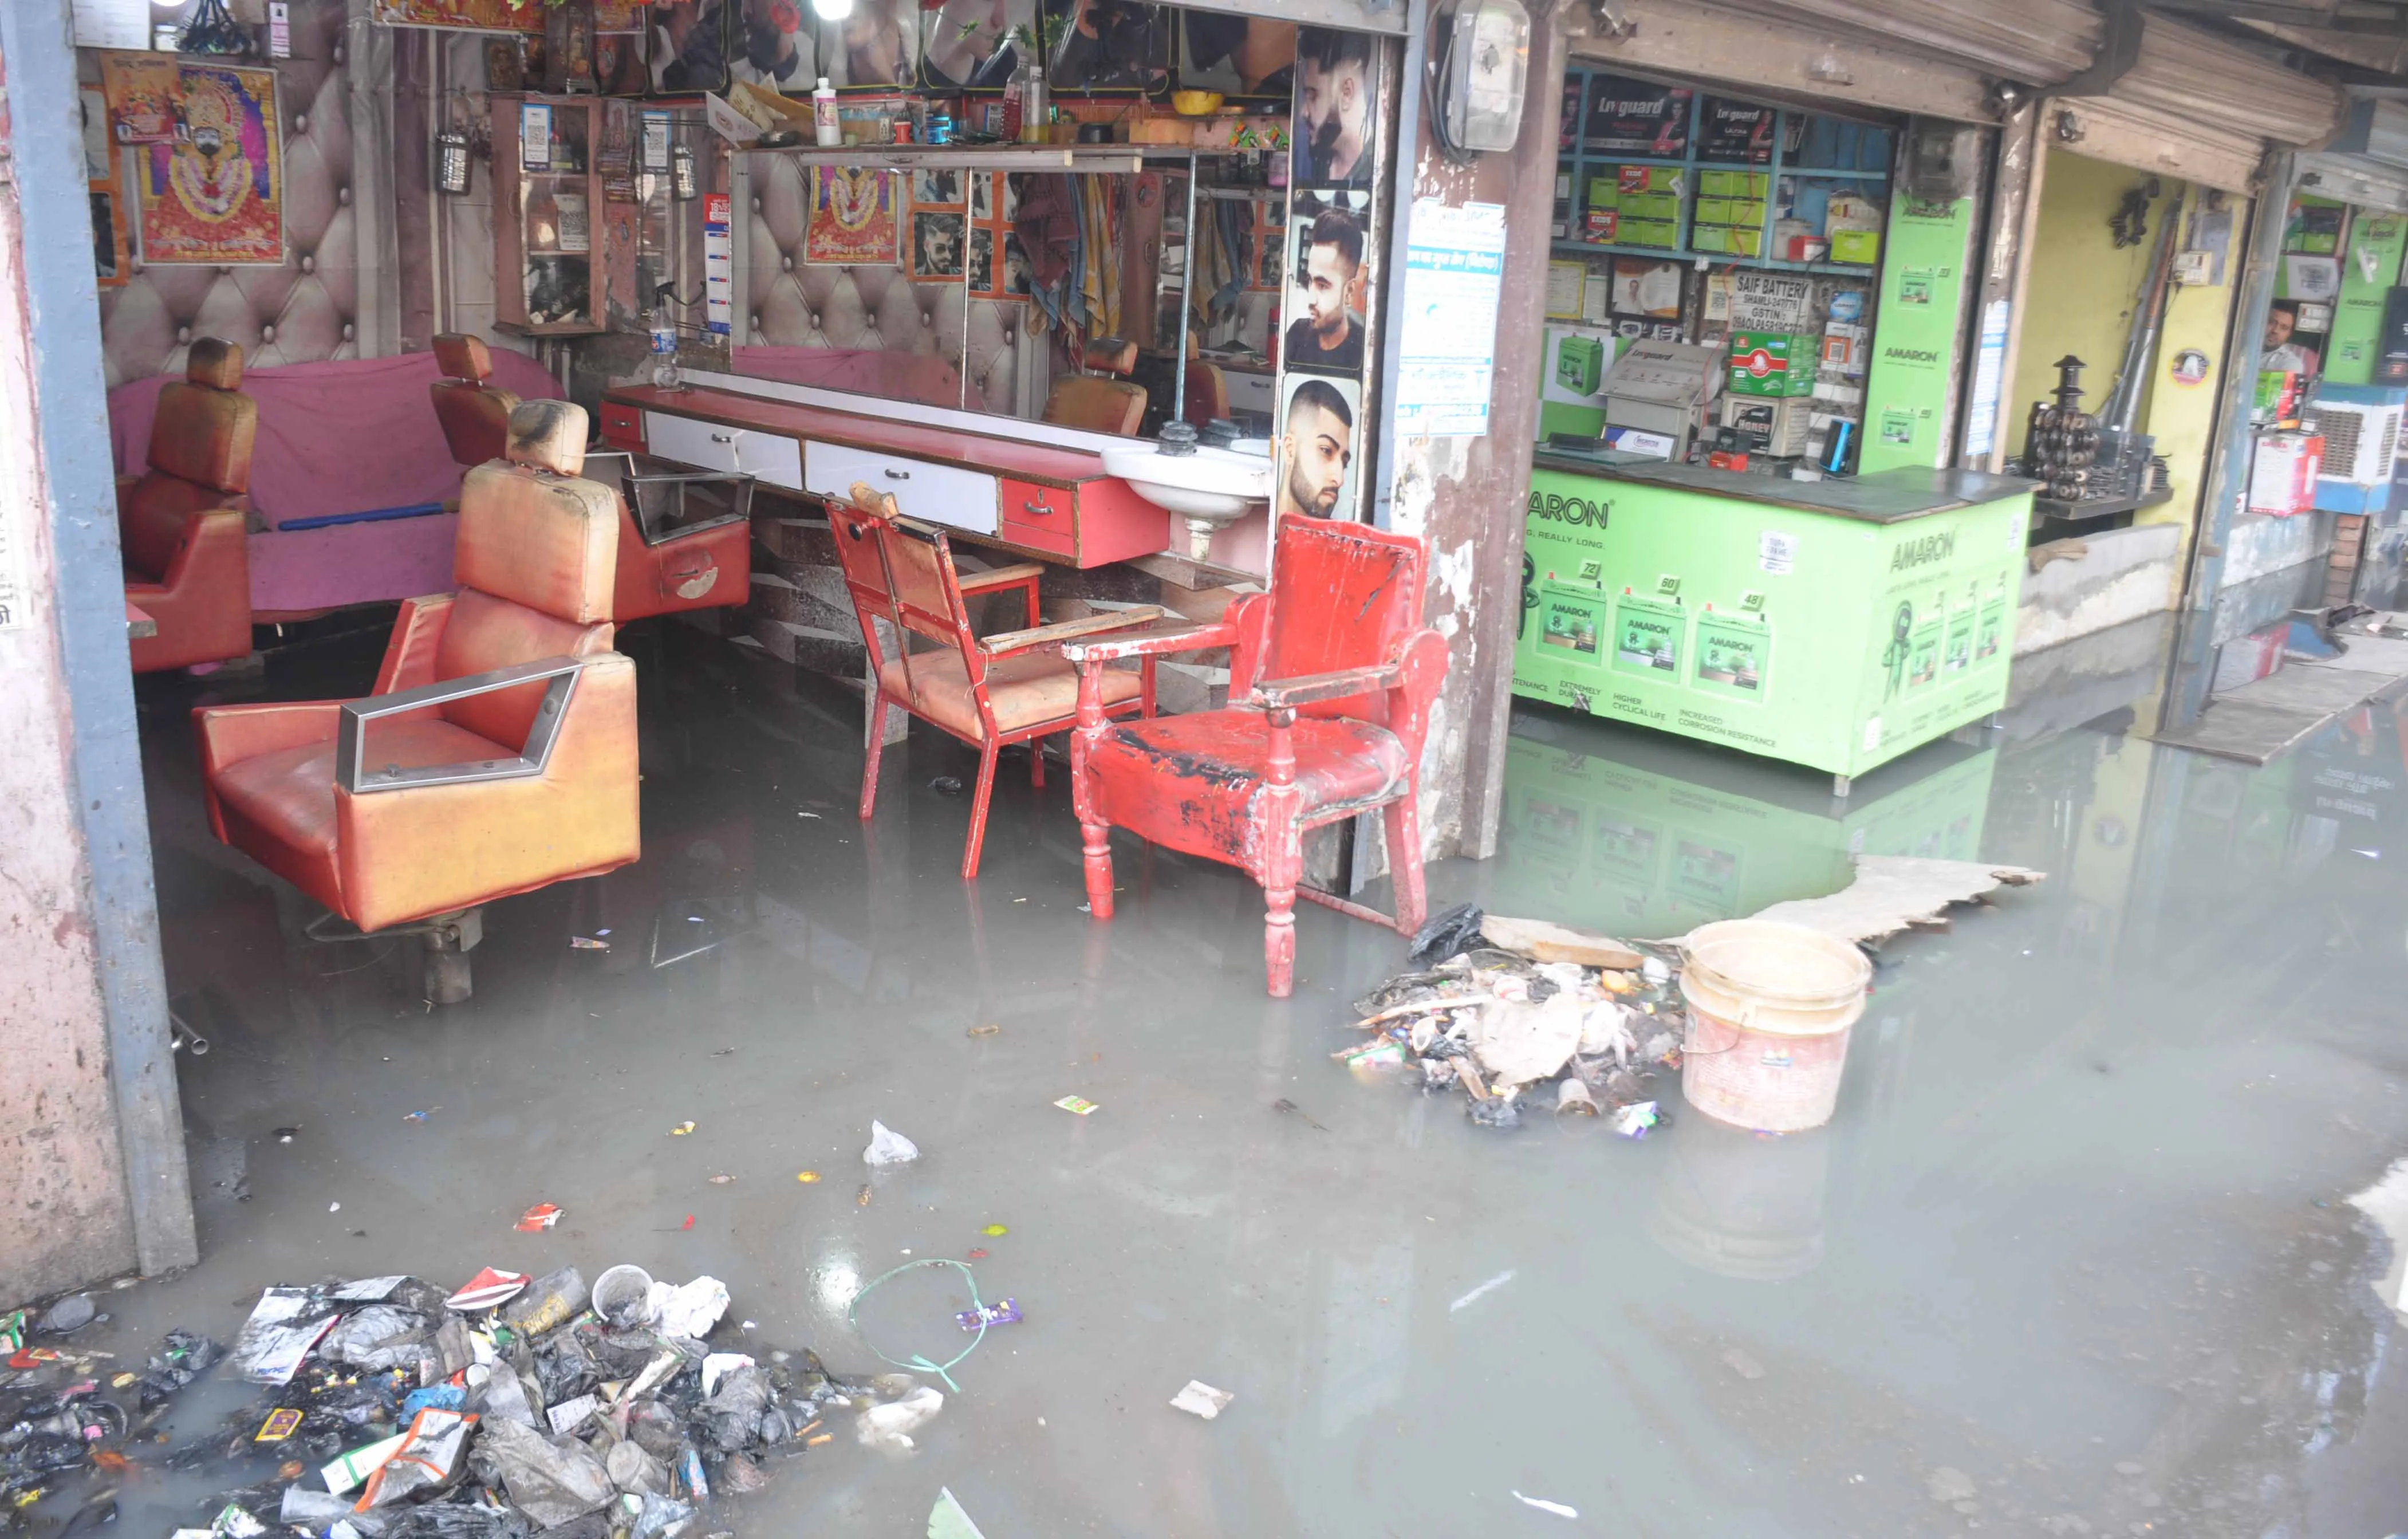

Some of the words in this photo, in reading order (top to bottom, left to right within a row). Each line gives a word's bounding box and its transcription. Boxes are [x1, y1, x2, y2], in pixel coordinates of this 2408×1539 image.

[1737, 275, 1760, 293] SAIF
[1762, 278, 1810, 299] BATTERY
[1752, 308, 1780, 319] GSTIN
[1884, 347, 1937, 363] AMARON
[1538, 530, 1572, 543] REALLY
[1889, 531, 1956, 573] AMARON
[1551, 603, 1590, 619] AMARON
[1627, 619, 1669, 635] AMARON
[1709, 636, 1753, 652] AMARON
[1559, 680, 1601, 695] EXTREMELY
[1613, 692, 1642, 705] HIGHER
[1612, 702, 1649, 718] CYCLICAL
[1650, 710, 1666, 721] LIFE
[1679, 709, 1723, 725] INCREASED
[1678, 718, 1726, 735] CORROSION
[1727, 730, 1776, 747] RESISTANCE
